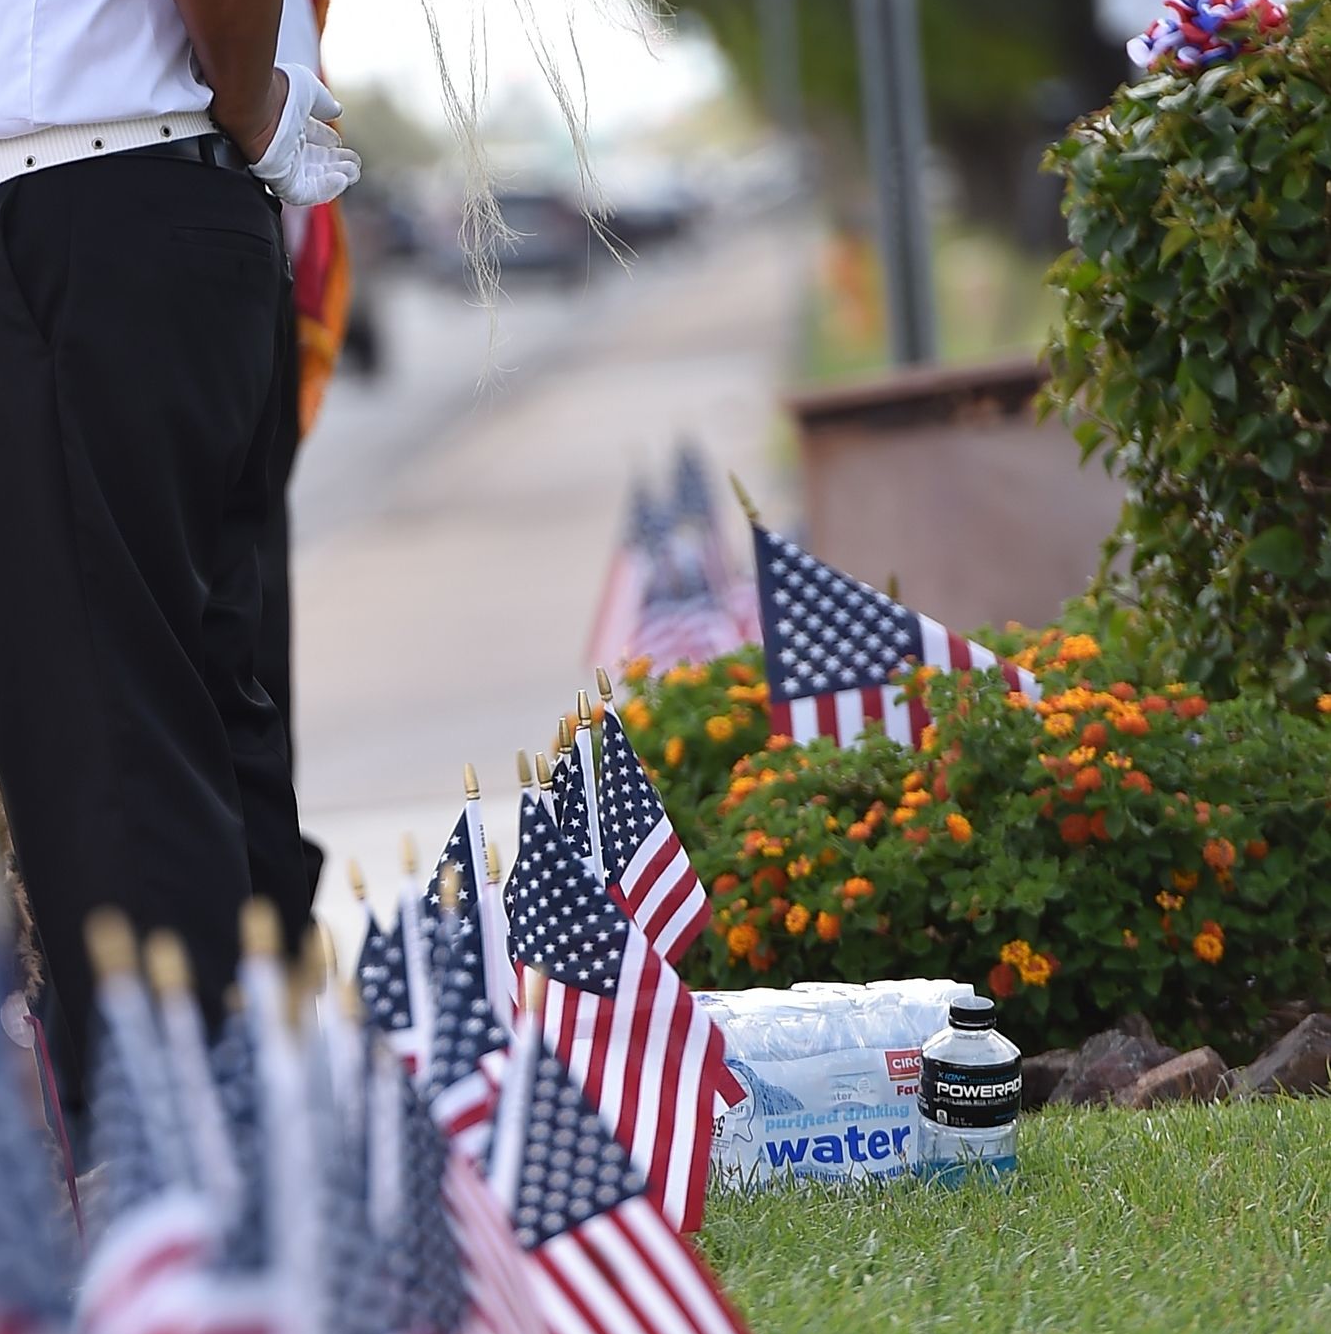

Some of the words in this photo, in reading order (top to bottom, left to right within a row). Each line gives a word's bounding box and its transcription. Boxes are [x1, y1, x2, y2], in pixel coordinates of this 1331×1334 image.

[892, 1056, 923, 1069] CIRC
[765, 1109, 839, 1132] purified
[843, 1103, 910, 1122] drinking
[765, 1125, 911, 1167] water
